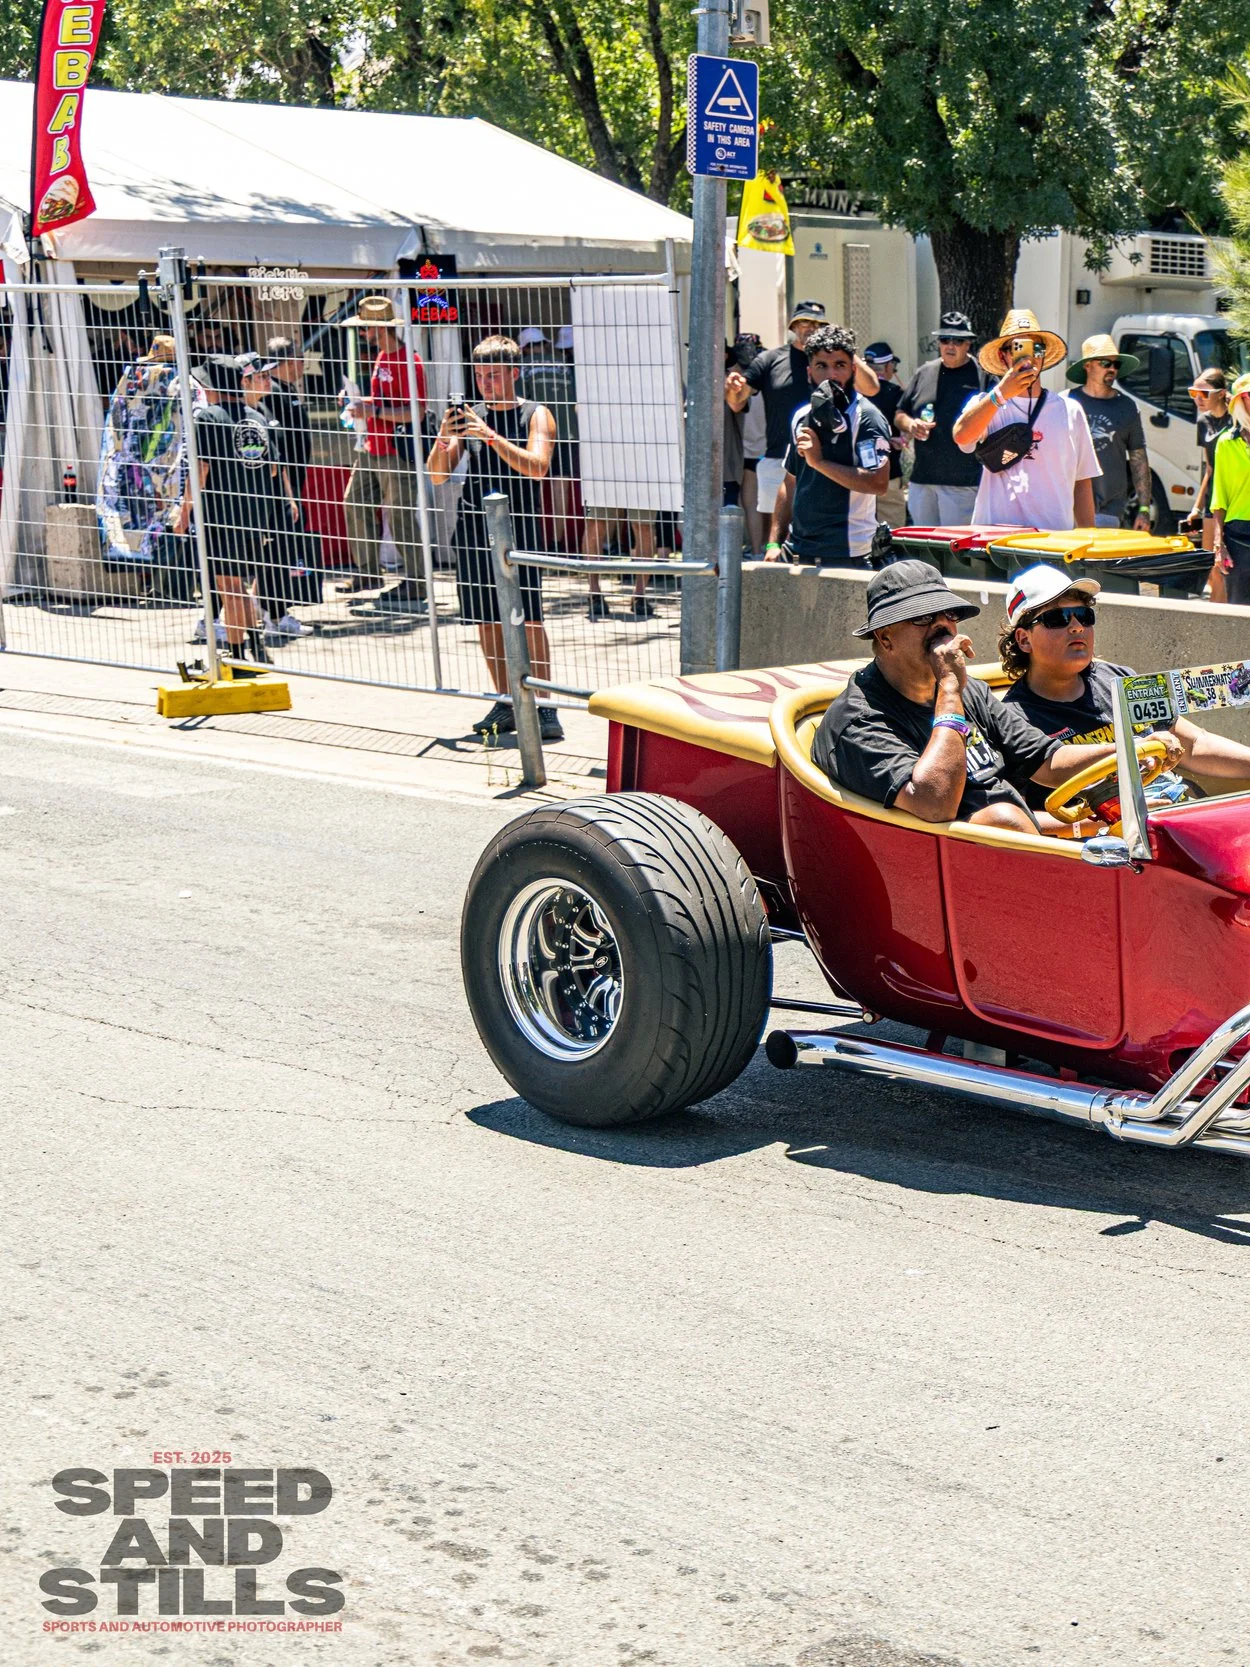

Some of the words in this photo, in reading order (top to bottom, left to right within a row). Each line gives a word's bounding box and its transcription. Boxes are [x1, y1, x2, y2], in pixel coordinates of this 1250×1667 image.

[48, 0, 98, 175] EBAB
[703, 121, 727, 132] SAFETY
[729, 124, 754, 135] CAMERA
[707, 134, 715, 143] IN
[717, 135, 732, 145] THIS
[734, 137, 750, 148] AREA
[411, 306, 458, 321] KEBAB
[1127, 686, 1165, 699] ENTRANT
[1172, 673, 1187, 713] ENTRANT
[1206, 687, 1217, 700] 38
[1133, 701, 1167, 720] 0435
